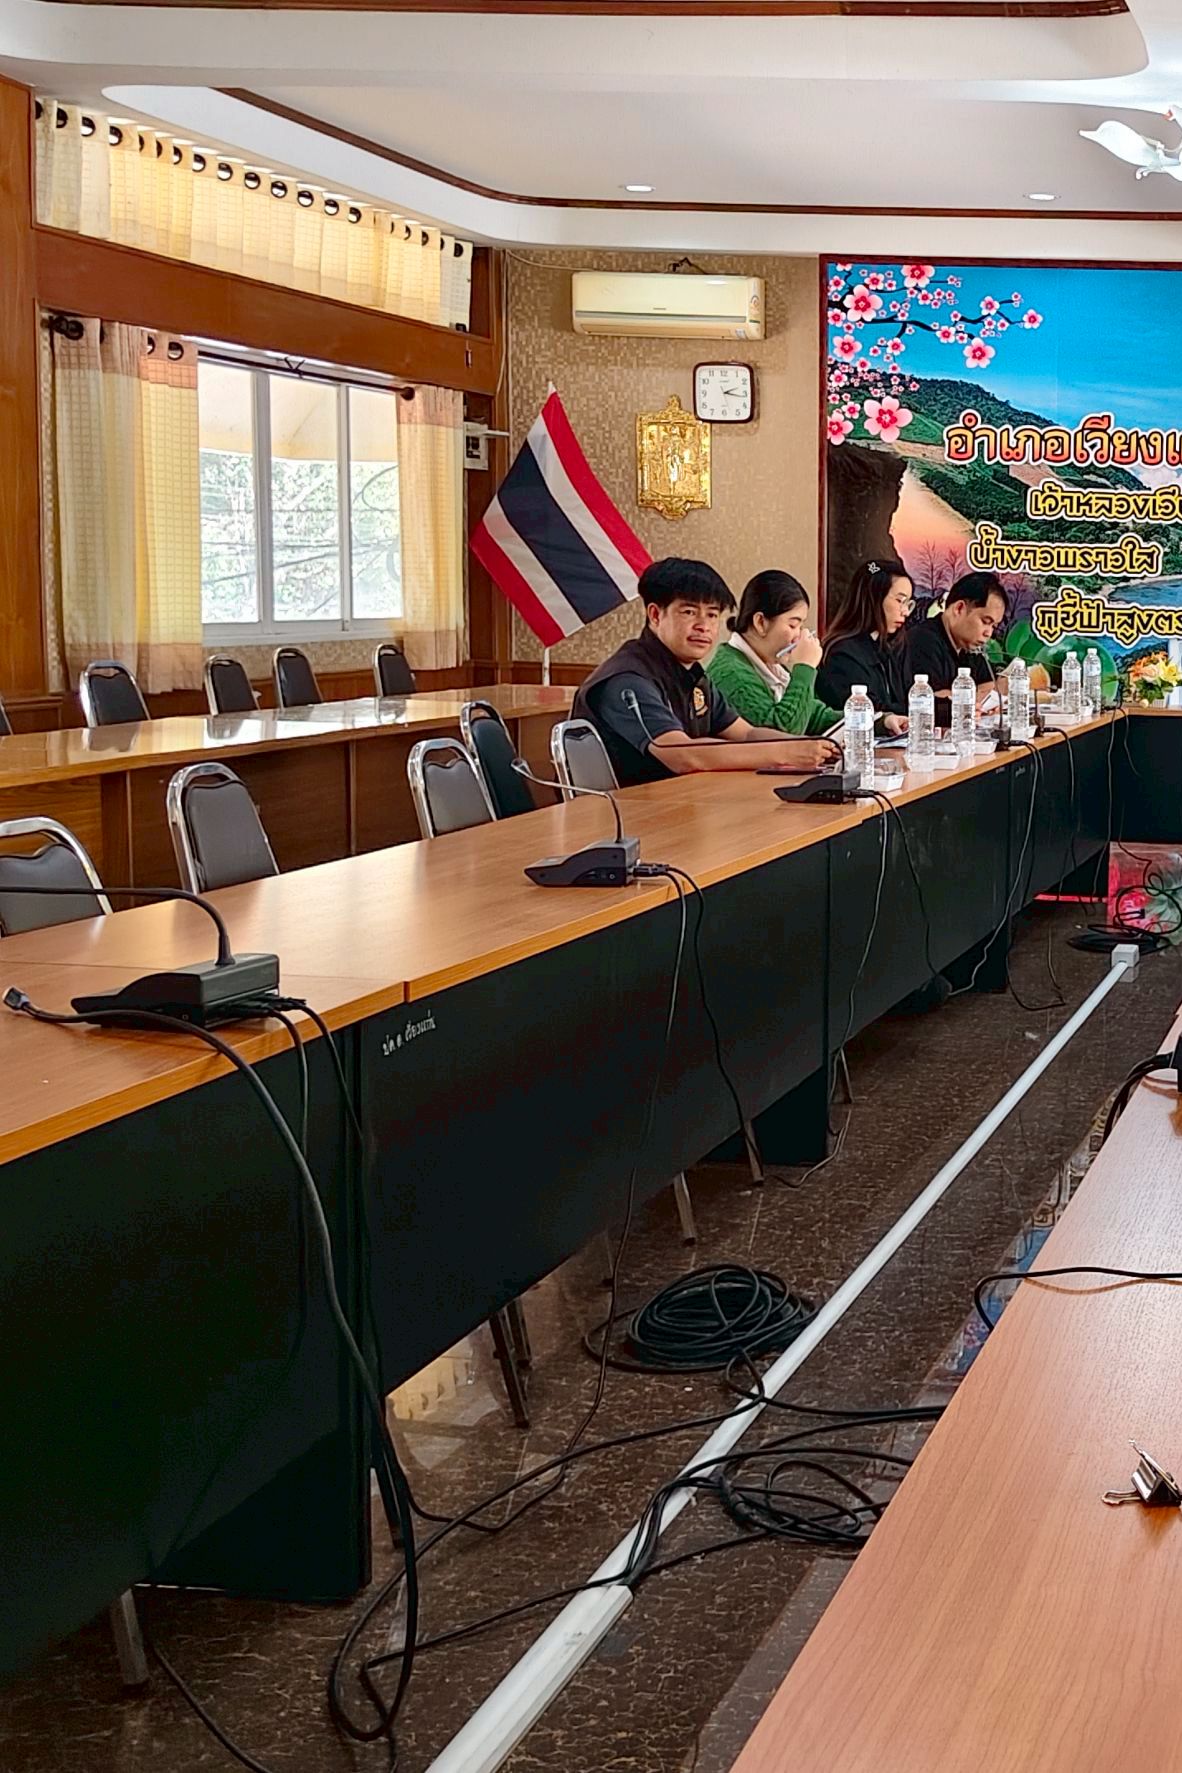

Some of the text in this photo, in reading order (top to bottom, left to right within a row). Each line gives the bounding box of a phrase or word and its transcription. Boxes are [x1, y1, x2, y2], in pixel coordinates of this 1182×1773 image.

[970, 527, 1160, 573] น้ำงาวพราวใส
